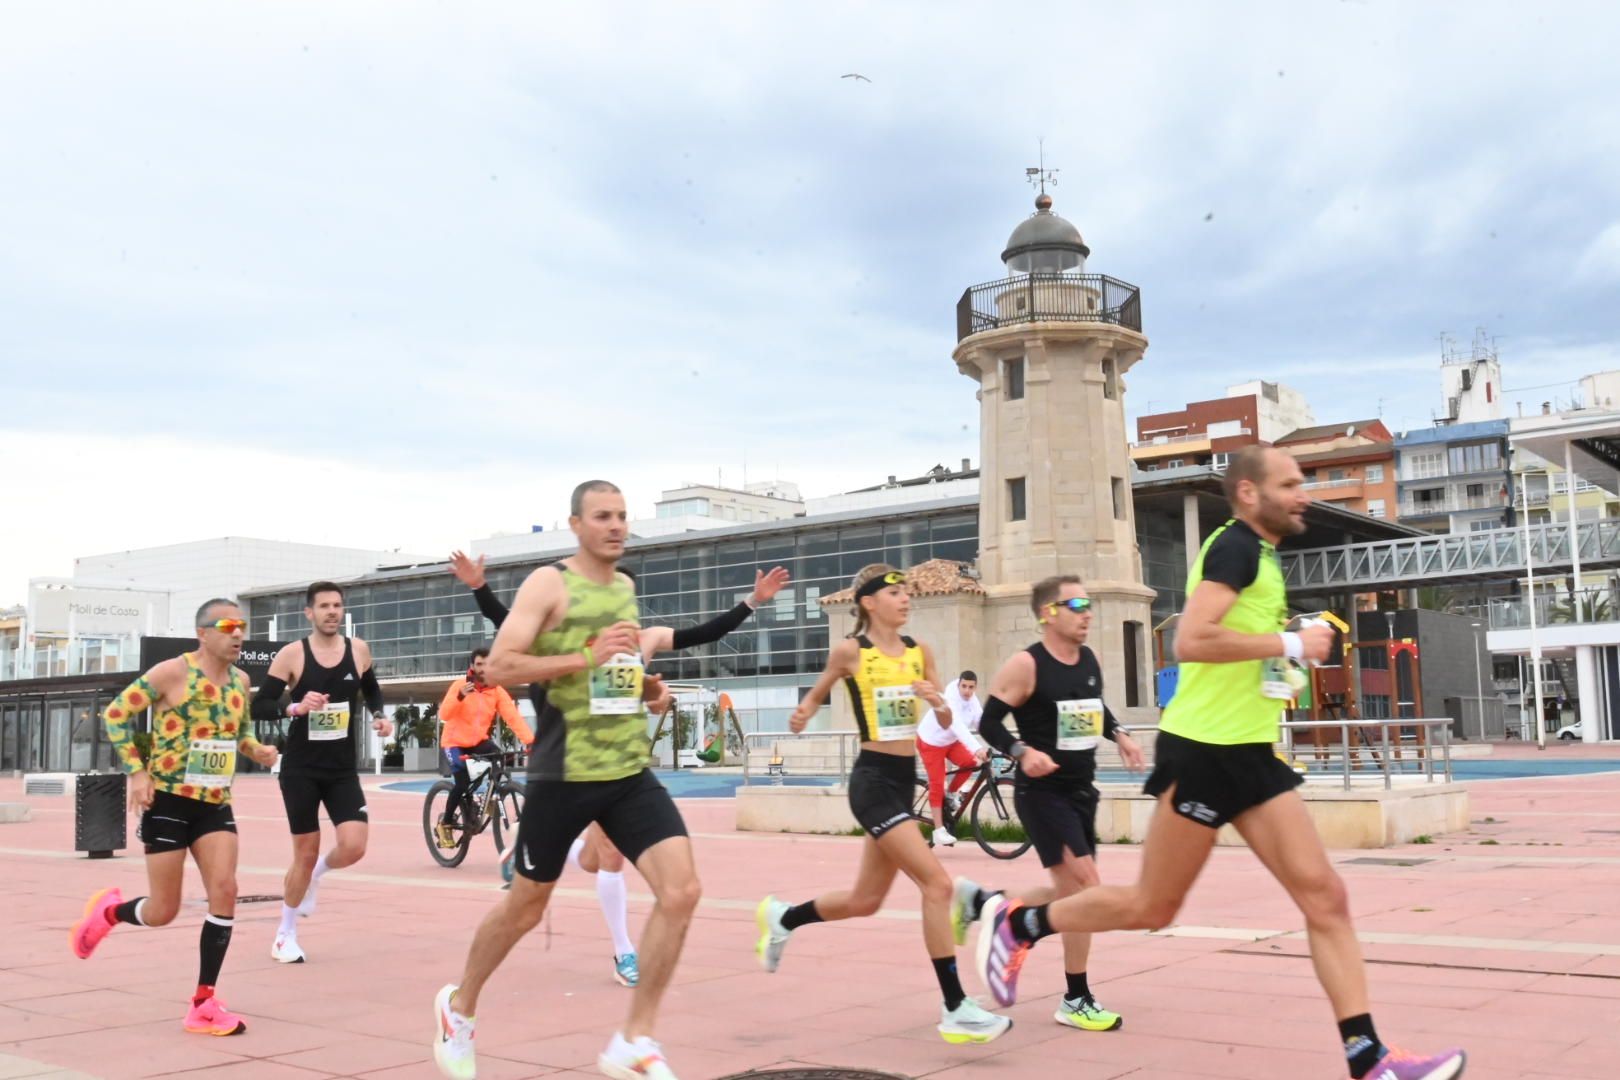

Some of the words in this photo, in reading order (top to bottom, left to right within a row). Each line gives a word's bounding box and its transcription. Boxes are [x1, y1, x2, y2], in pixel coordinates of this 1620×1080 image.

[69, 602, 91, 614] Moll
[94, 604, 107, 615] de
[239, 650, 257, 660] Moll
[257, 651, 269, 661] de
[604, 668, 635, 689] 152
[318, 712, 342, 726] 251
[1069, 713, 1094, 730] 264
[201, 752, 227, 769] 100
